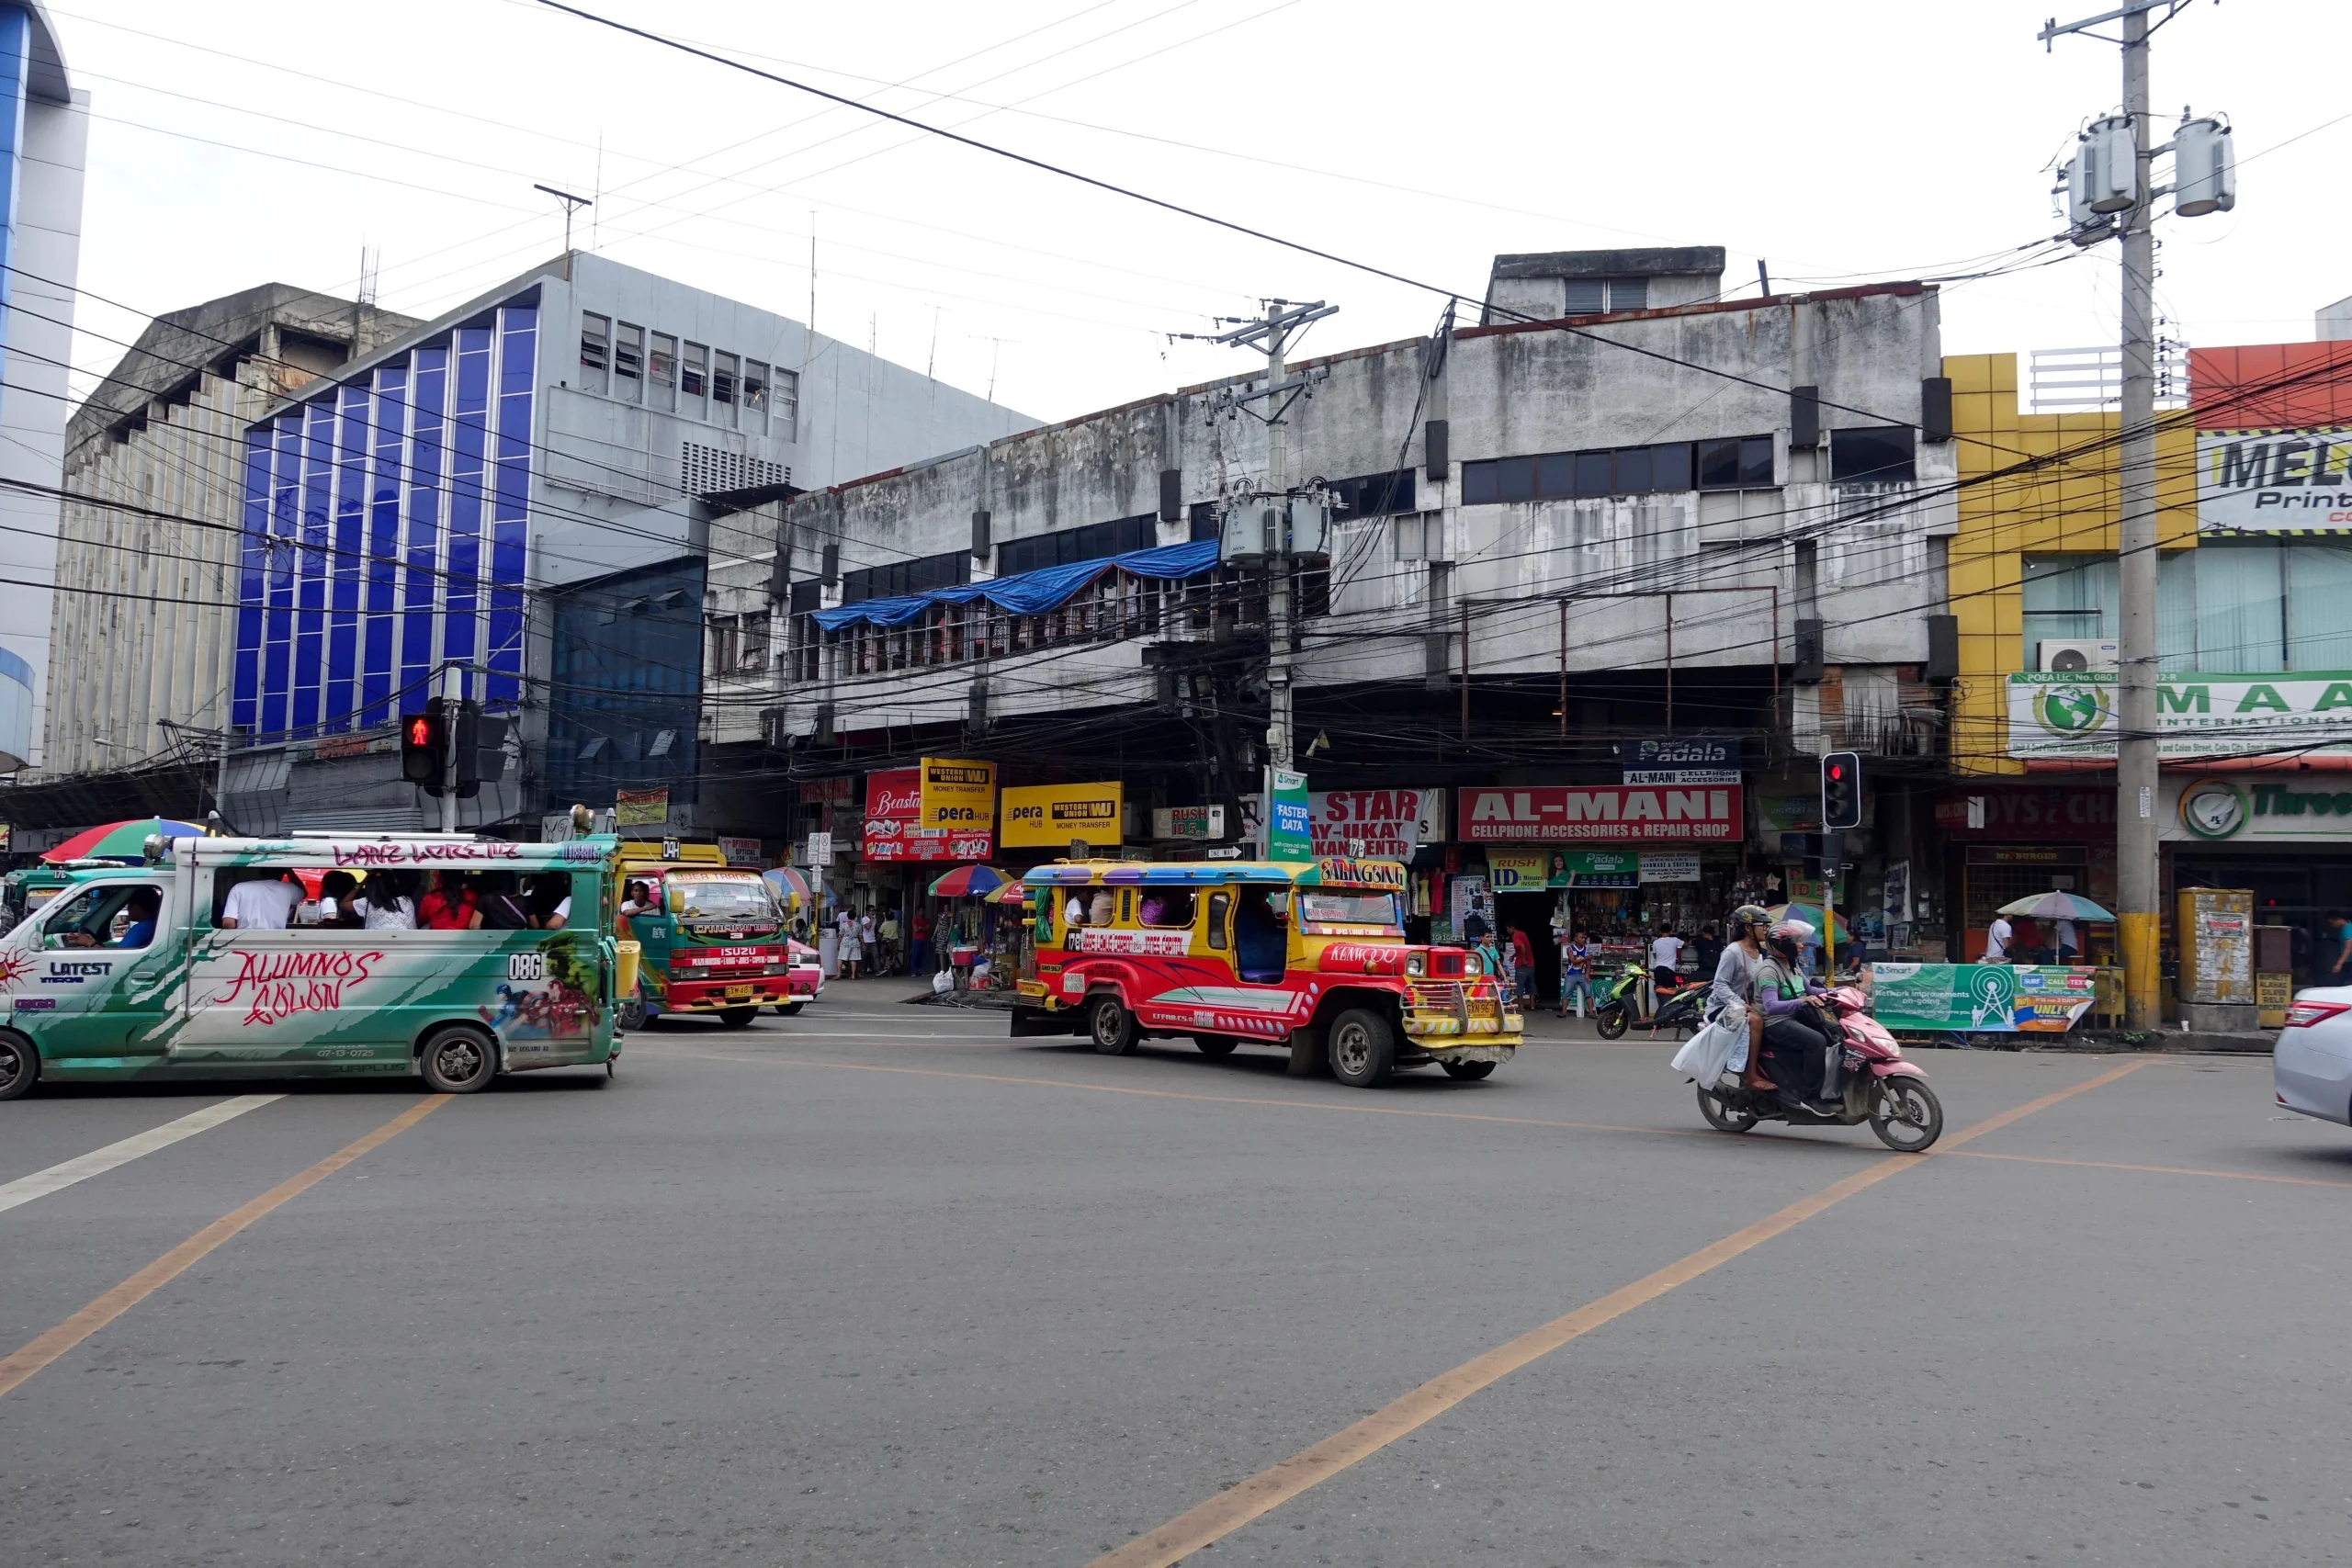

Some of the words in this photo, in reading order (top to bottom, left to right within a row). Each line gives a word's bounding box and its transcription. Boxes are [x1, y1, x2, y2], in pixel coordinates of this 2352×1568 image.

[2220, 442, 2352, 488] MEL
[1639, 740, 1725, 761] Padala
[2175, 743, 2192, 752] Colon
[940, 774, 964, 783] UNION
[1283, 775, 1299, 785] Smart
[1630, 772, 1676, 784] AL-MANI
[1054, 803, 1088, 811] WESTERN
[1276, 805, 1308, 818] FASTER
[1327, 791, 1419, 822] STAR
[1471, 790, 1729, 821] AL-MANI
[938, 807, 974, 821] pera
[975, 813, 989, 821] HUB
[1012, 807, 1043, 820] pera
[1172, 809, 1208, 821] RUSH
[1172, 823, 1185, 835] ID
[1282, 818, 1304, 831] DATA
[1471, 825, 1539, 838] CELLPHONE
[1541, 824, 1629, 838] ACCESSORIES
[1631, 825, 1642, 837] &
[1644, 824, 1690, 837] REPAIR
[1692, 823, 1730, 837] SHOP
[1586, 852, 1624, 863] Padala
[2016, 852, 2058, 861] BURGER
[1498, 859, 1537, 867] RUSH
[1494, 868, 1519, 886] ID
[721, 947, 756, 955] ISUZU
[1330, 945, 1397, 963] KENWOOD
[50, 962, 113, 976] LATEST
[213, 950, 384, 1004] ALUMNOS
[1911, 990, 1970, 998] improvements
[2033, 1004, 2062, 1014] UNLI
[317, 1049, 375, 1057] 07-13-0725
[330, 1063, 406, 1073] SURPLUS
